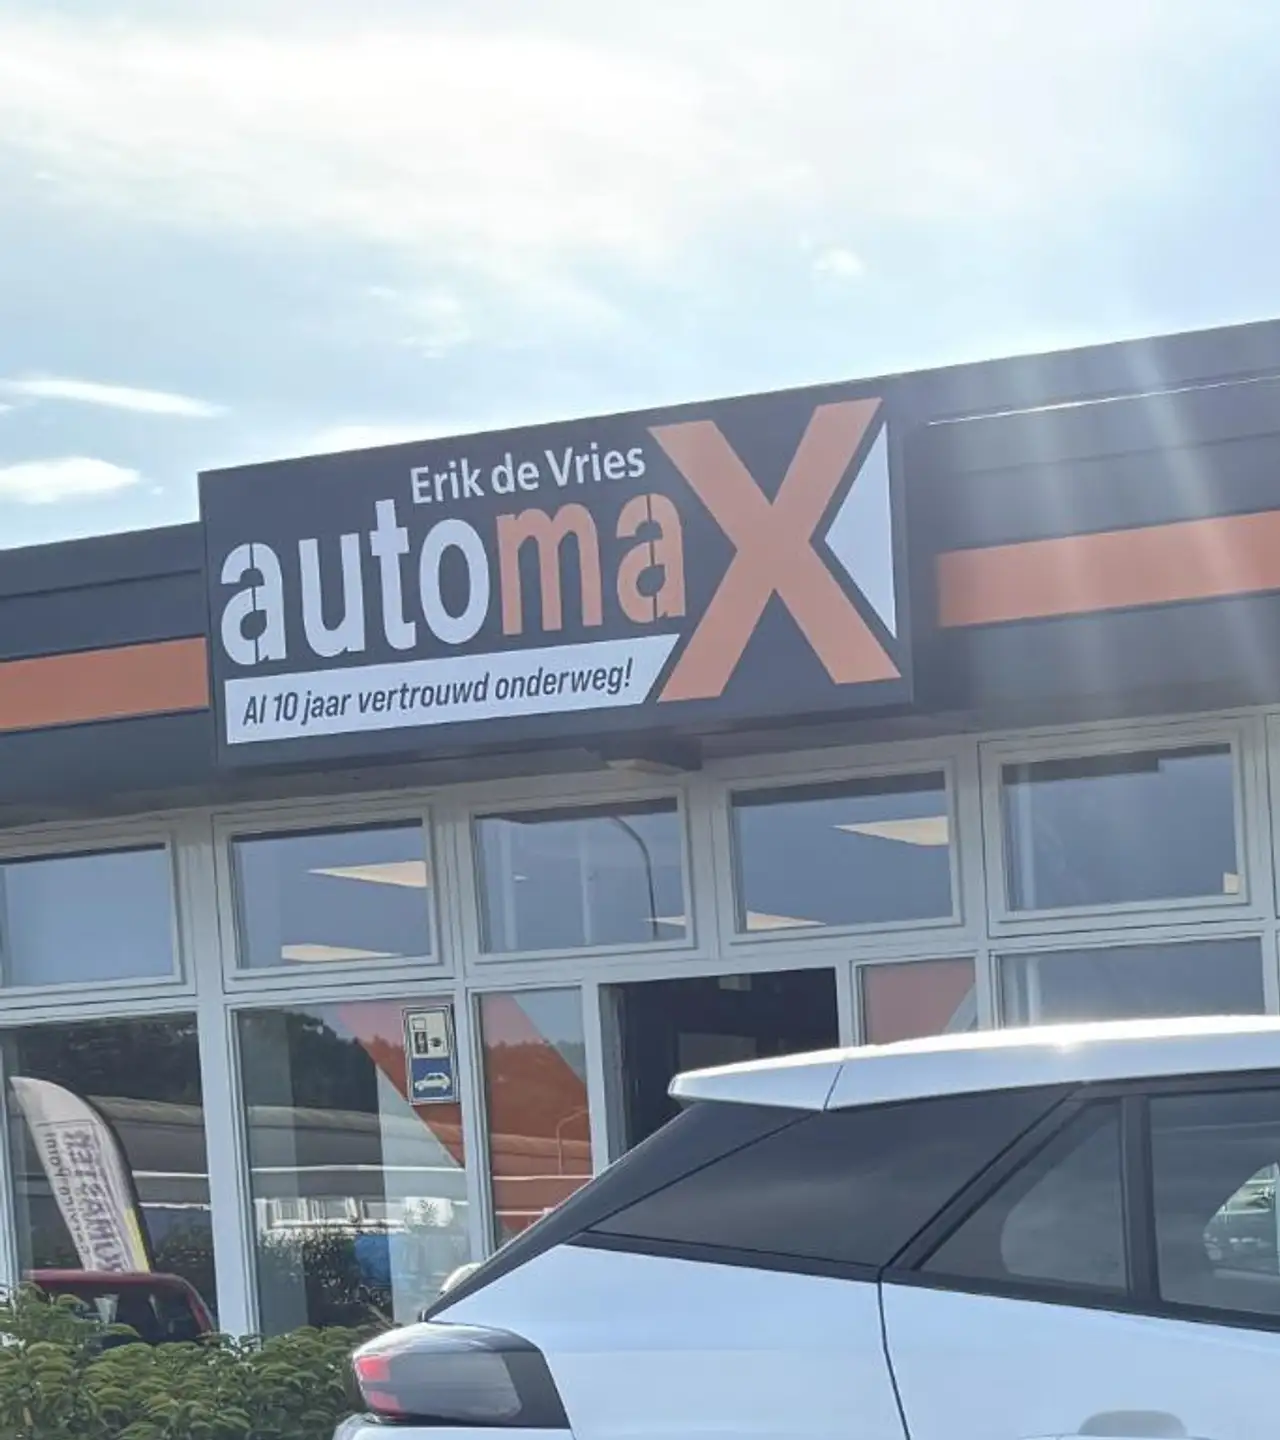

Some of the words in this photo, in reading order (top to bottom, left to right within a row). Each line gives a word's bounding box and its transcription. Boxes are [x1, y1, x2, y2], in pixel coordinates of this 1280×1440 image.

[410, 458, 485, 503] Erik
[491, 452, 540, 494] de
[544, 442, 646, 487] Vries
[273, 691, 298, 723] 10
[300, 693, 350, 726] jaar
[358, 672, 490, 715] vertrouwd
[494, 657, 633, 701] onderweg!
